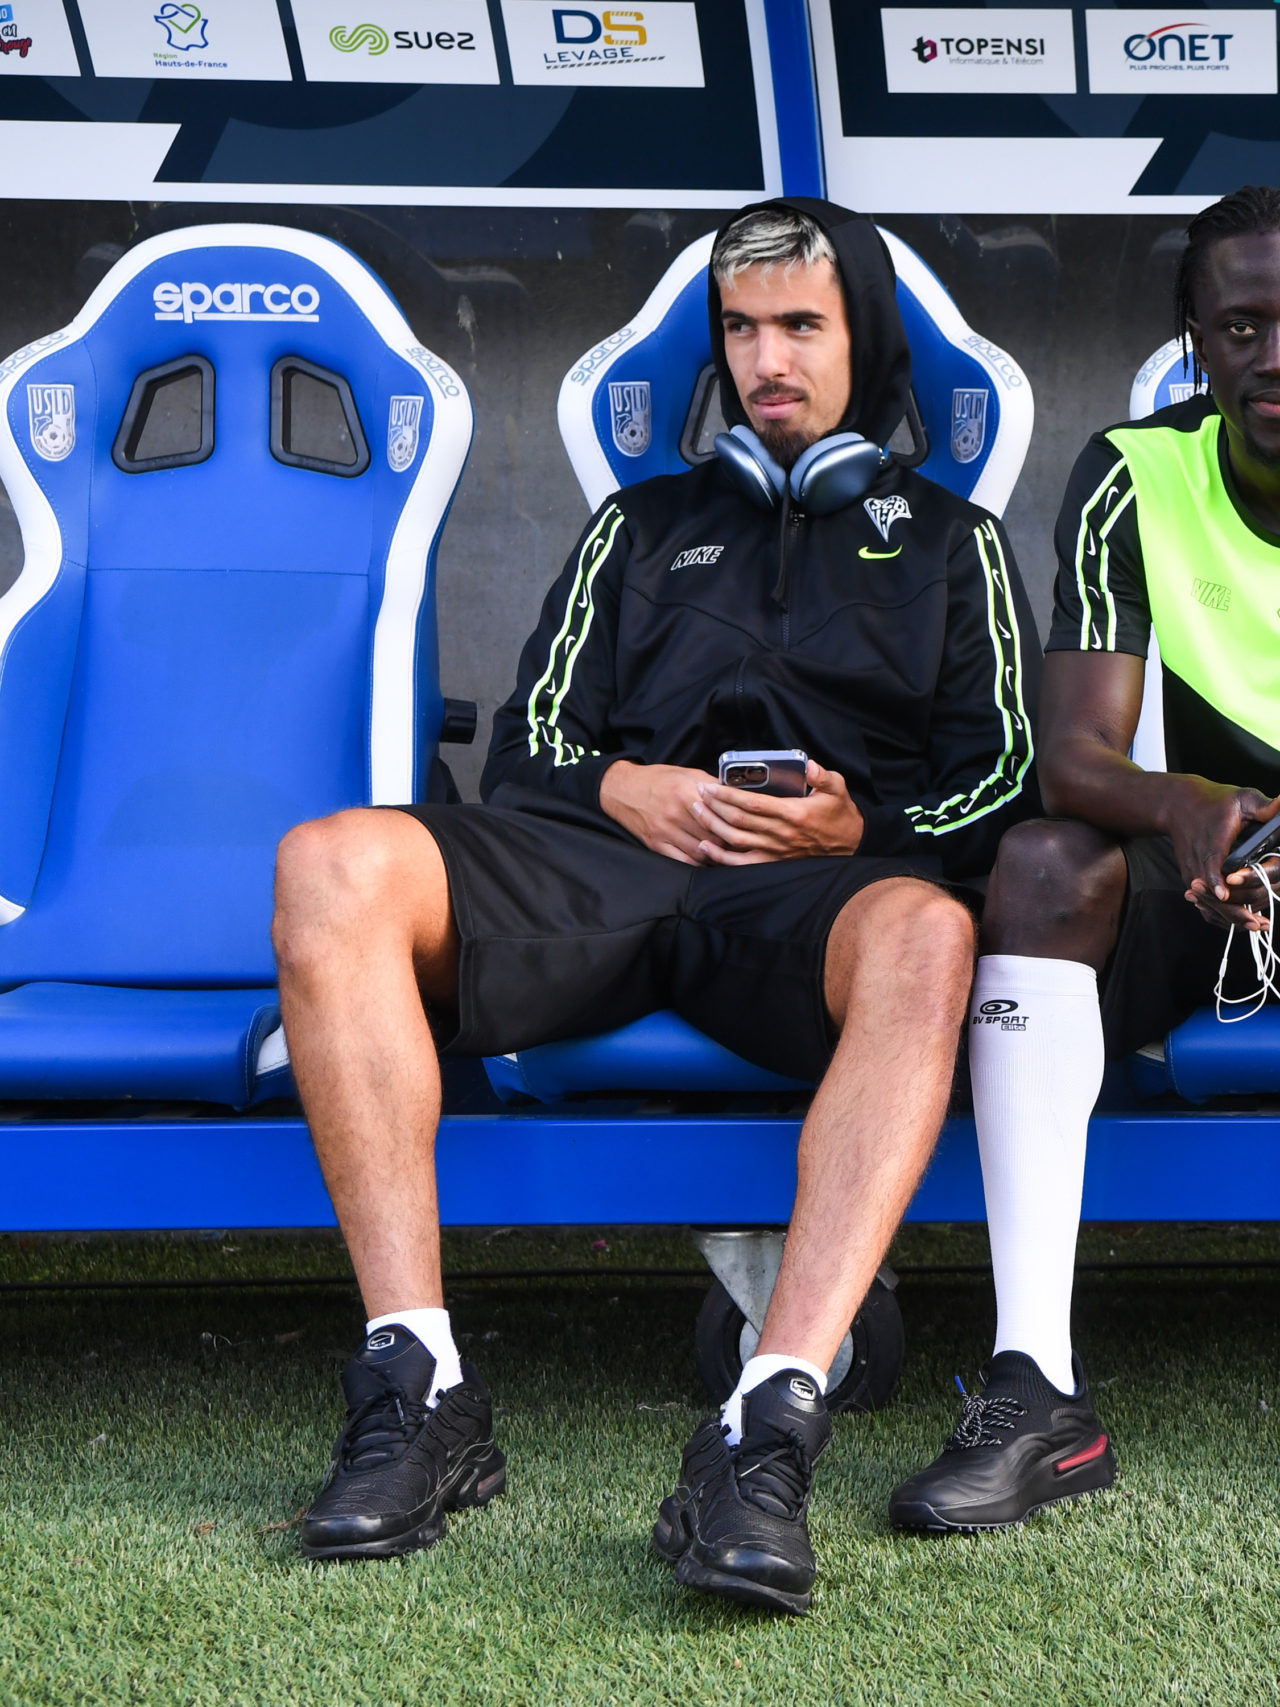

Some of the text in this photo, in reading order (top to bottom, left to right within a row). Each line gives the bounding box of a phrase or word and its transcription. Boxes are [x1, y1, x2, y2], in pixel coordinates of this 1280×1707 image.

[394, 31, 476, 50] suez
[552, 9, 648, 46] DS
[543, 47, 635, 64] LEVAGE
[940, 37, 1046, 56] TOPENSI
[155, 60, 228, 68] Hauts-de-France
[949, 57, 1000, 66] Informatique
[153, 281, 320, 323] sparco
[570, 328, 633, 383] sparco
[966, 336, 1022, 388] sparco
[409, 347, 460, 397] sparco
[33, 388, 71, 414] USLD
[613, 387, 647, 412] USLD
[670, 545, 724, 571] NIKE
[1191, 577, 1231, 612] NIKE
[985, 1016, 1029, 1024] SPORT
